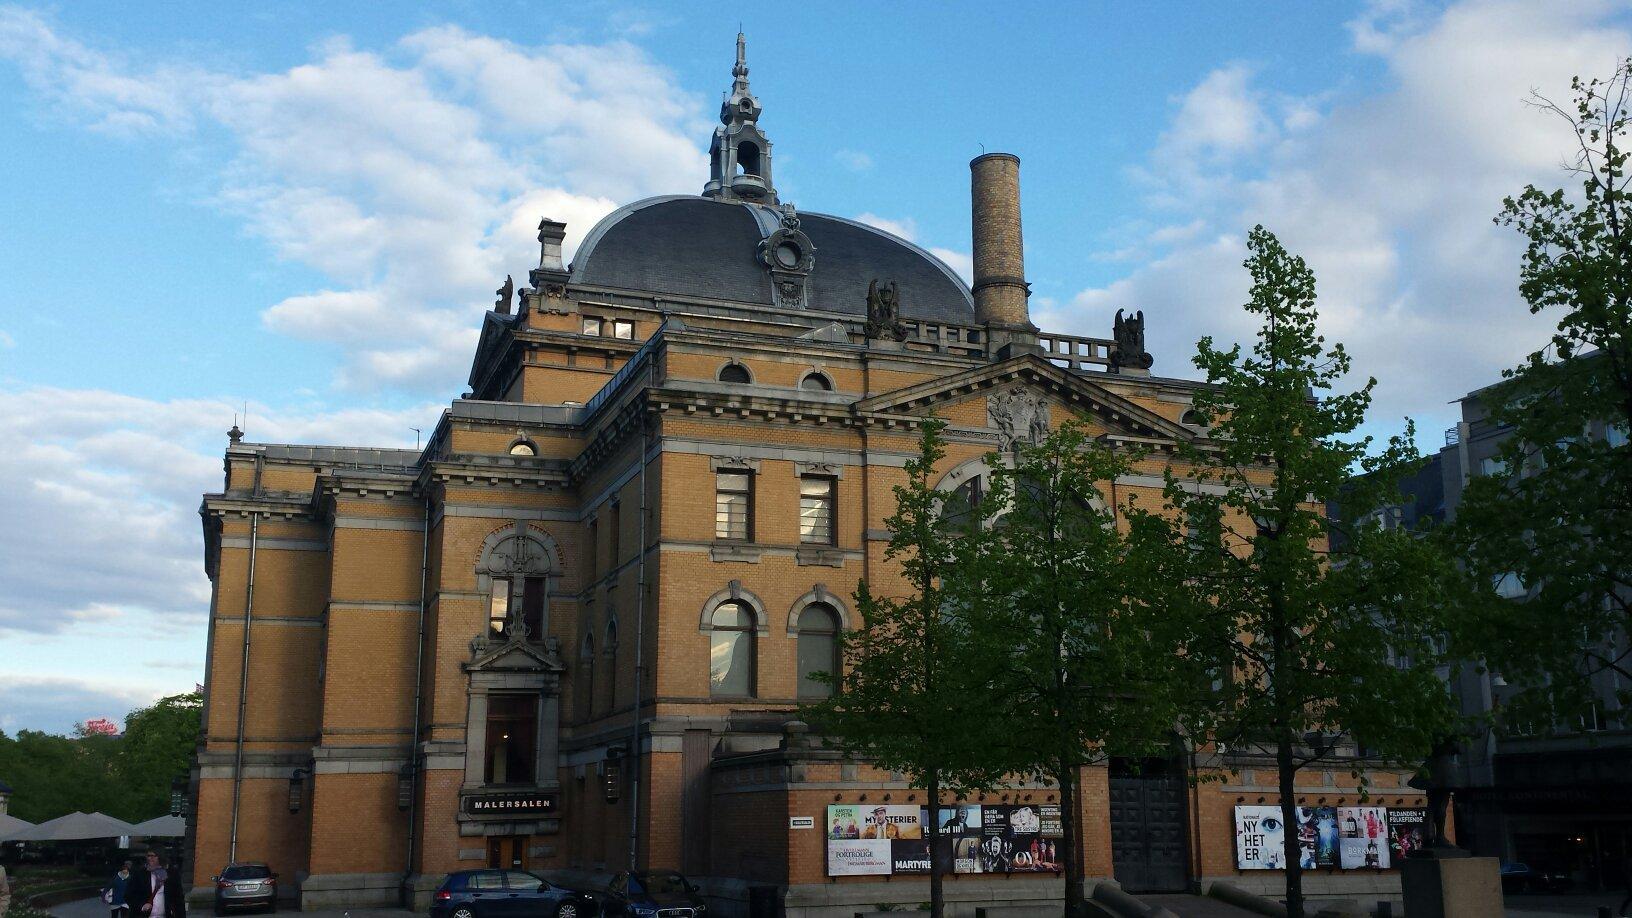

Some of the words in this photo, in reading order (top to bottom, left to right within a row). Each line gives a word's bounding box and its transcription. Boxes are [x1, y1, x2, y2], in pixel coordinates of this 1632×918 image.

[474, 800, 550, 809] MALERSALEN
[865, 815, 917, 824] MYSTERIER
[1243, 821, 1258, 833] NY
[1244, 834, 1265, 847] HET
[1245, 848, 1260, 861] ER
[895, 860, 932, 869] MARTYRE
